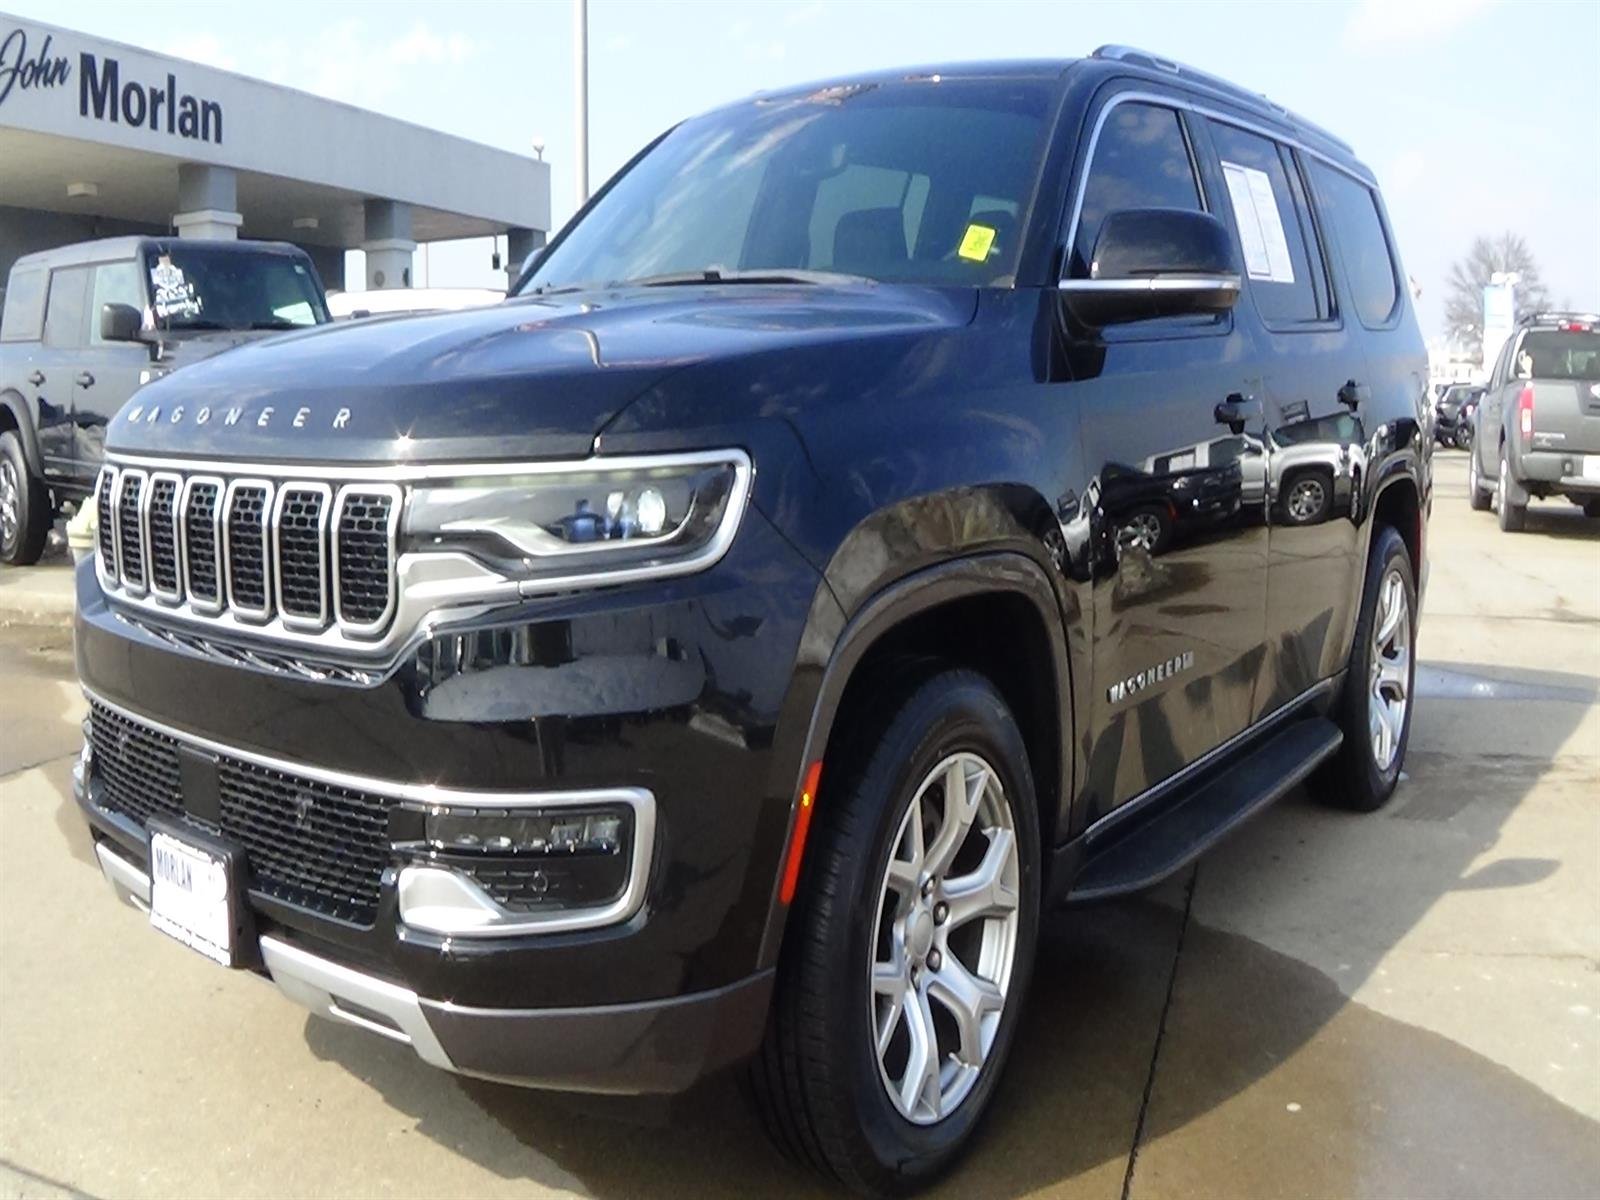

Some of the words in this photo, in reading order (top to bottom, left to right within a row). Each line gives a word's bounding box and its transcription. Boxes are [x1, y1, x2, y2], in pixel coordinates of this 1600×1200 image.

[0, 29, 70, 106] John
[79, 52, 222, 144] Morlan
[156, 848, 192, 892] MORLAN
